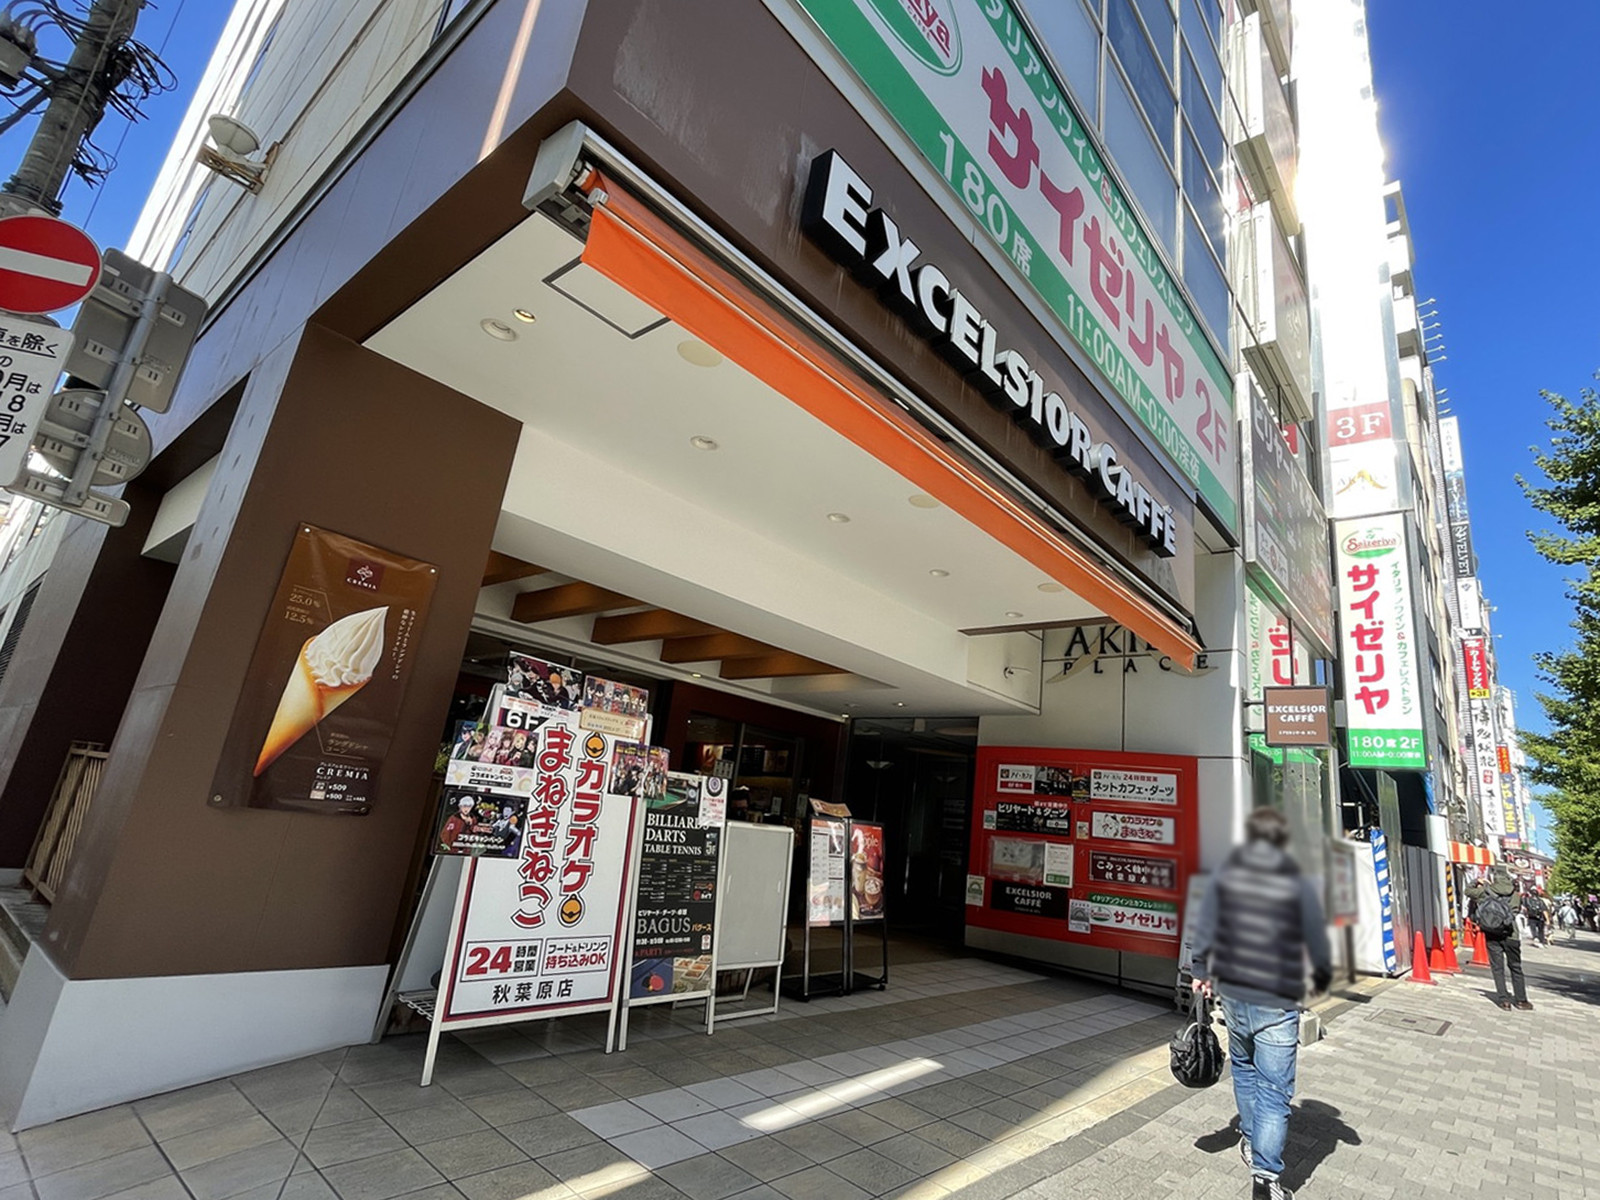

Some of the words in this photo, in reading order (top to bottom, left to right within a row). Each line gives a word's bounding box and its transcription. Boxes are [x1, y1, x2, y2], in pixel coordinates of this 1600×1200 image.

[939, 130, 1032, 277] 180席
[981, 65, 1185, 406] サイゼリヤ
[1194, 377, 1228, 467] 2F
[817, 147, 1093, 474] EXCELSIOR
[1335, 410, 1385, 440] 3F
[1064, 625, 1208, 657] AKI
[1346, 563, 1390, 716] サイゼリヤ
[1063, 654, 1209, 676] PLACE
[1268, 705, 1327, 714] EXCELSIOR
[506, 710, 540, 730] 6F
[1399, 735, 1421, 749] 2F
[316, 766, 369, 781] CREMIA
[1093, 781, 1175, 797] ネットカフェ・ダーツ
[511, 723, 576, 928] まねきねこ
[561, 759, 607, 894] カラオケ
[645, 827, 687, 843] DARTS
[644, 843, 671, 854] TABLE
[672, 844, 702, 855] TENNIS
[1005, 886, 1052, 900] EXCELSIOR
[636, 917, 691, 934] BAGUS
[1113, 910, 1176, 931] サイゼリヤ
[465, 945, 512, 977] 24
[515, 944, 538, 959] 時間
[544, 952, 608, 970] 持ち込みOK
[512, 958, 536, 973] 営業
[491, 978, 574, 1005] 秋葉原店
